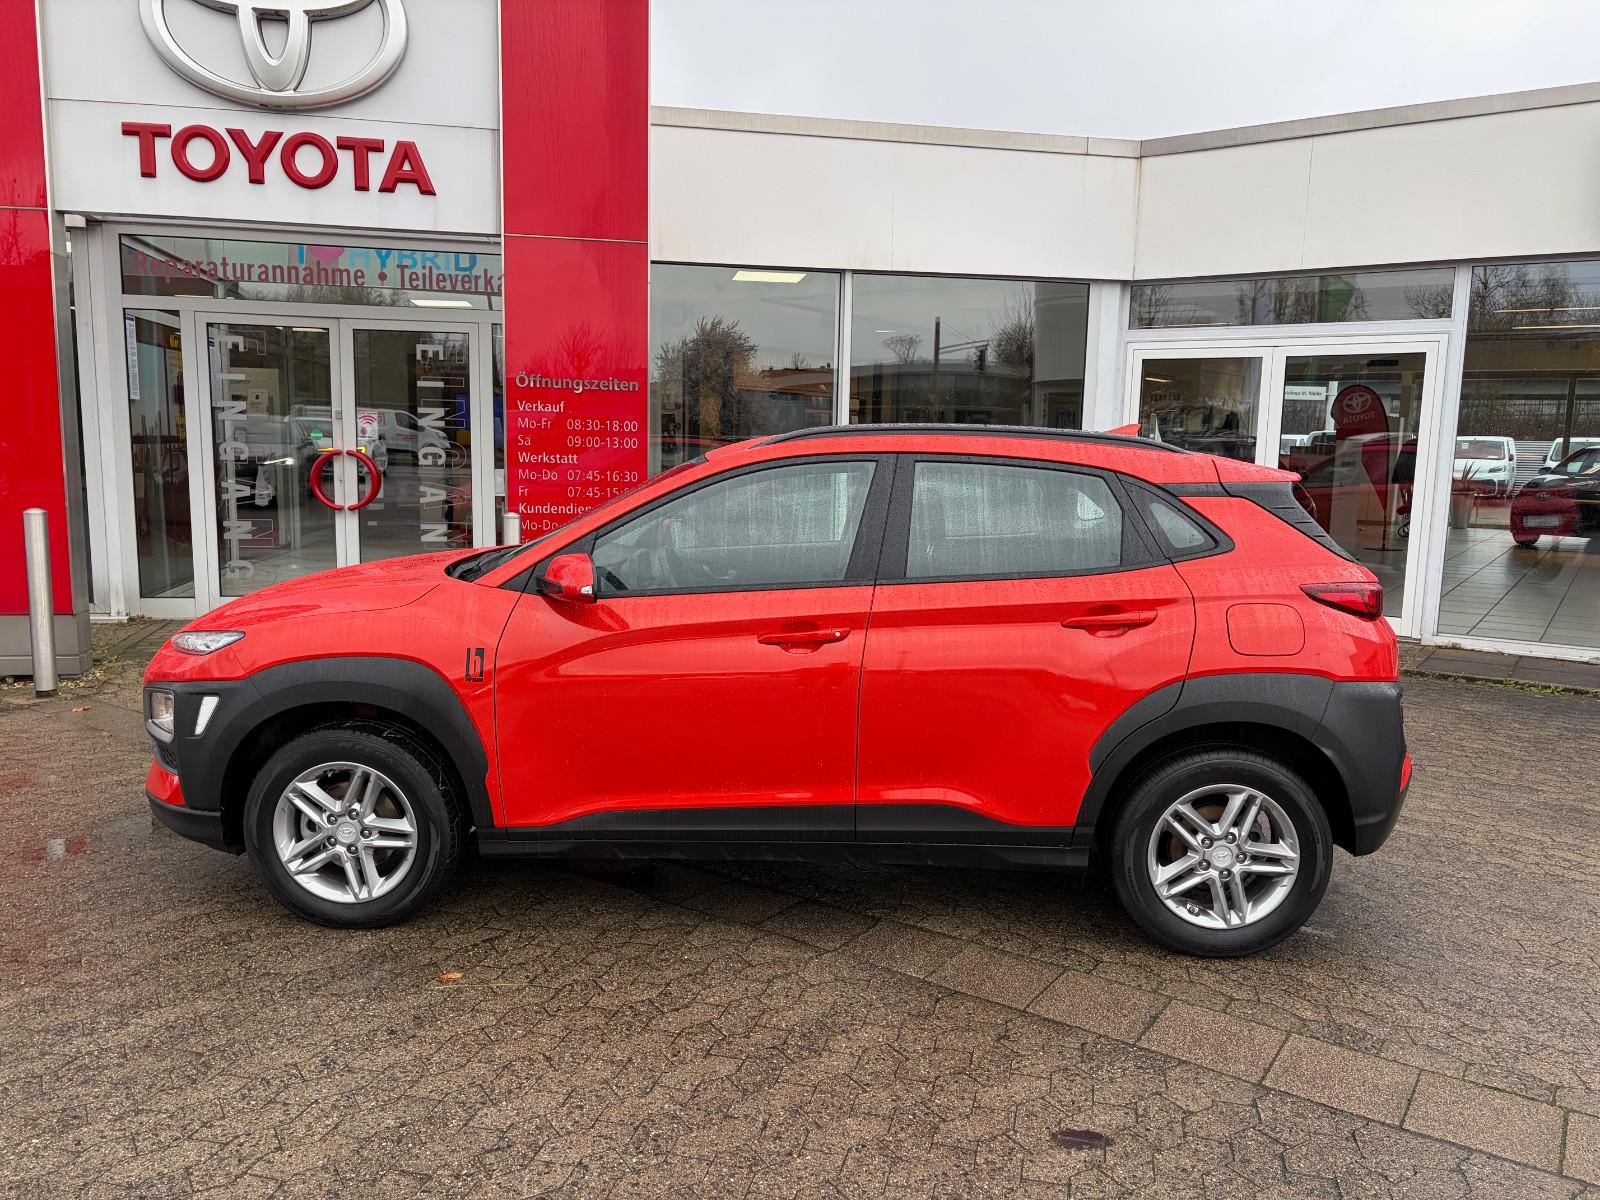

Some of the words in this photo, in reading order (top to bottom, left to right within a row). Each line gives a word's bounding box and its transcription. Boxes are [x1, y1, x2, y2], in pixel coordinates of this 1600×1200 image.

[121, 121, 437, 196] TOYOTA
[347, 247, 478, 272] HYBRID
[132, 252, 366, 287] Reparaturannahme
[515, 371, 640, 394] Öffnungszeiten
[517, 400, 565, 413] Verkauf
[517, 418, 552, 429] Mo-Fr
[567, 419, 639, 432] 08:30-18:00
[517, 435, 532, 446] Sa
[567, 436, 639, 449] 09:00-13:00
[518, 452, 579, 465] Werkstatt
[518, 469, 558, 481] Mo-Do
[567, 470, 639, 482] 07:45-16:30
[518, 486, 529, 496] Fr
